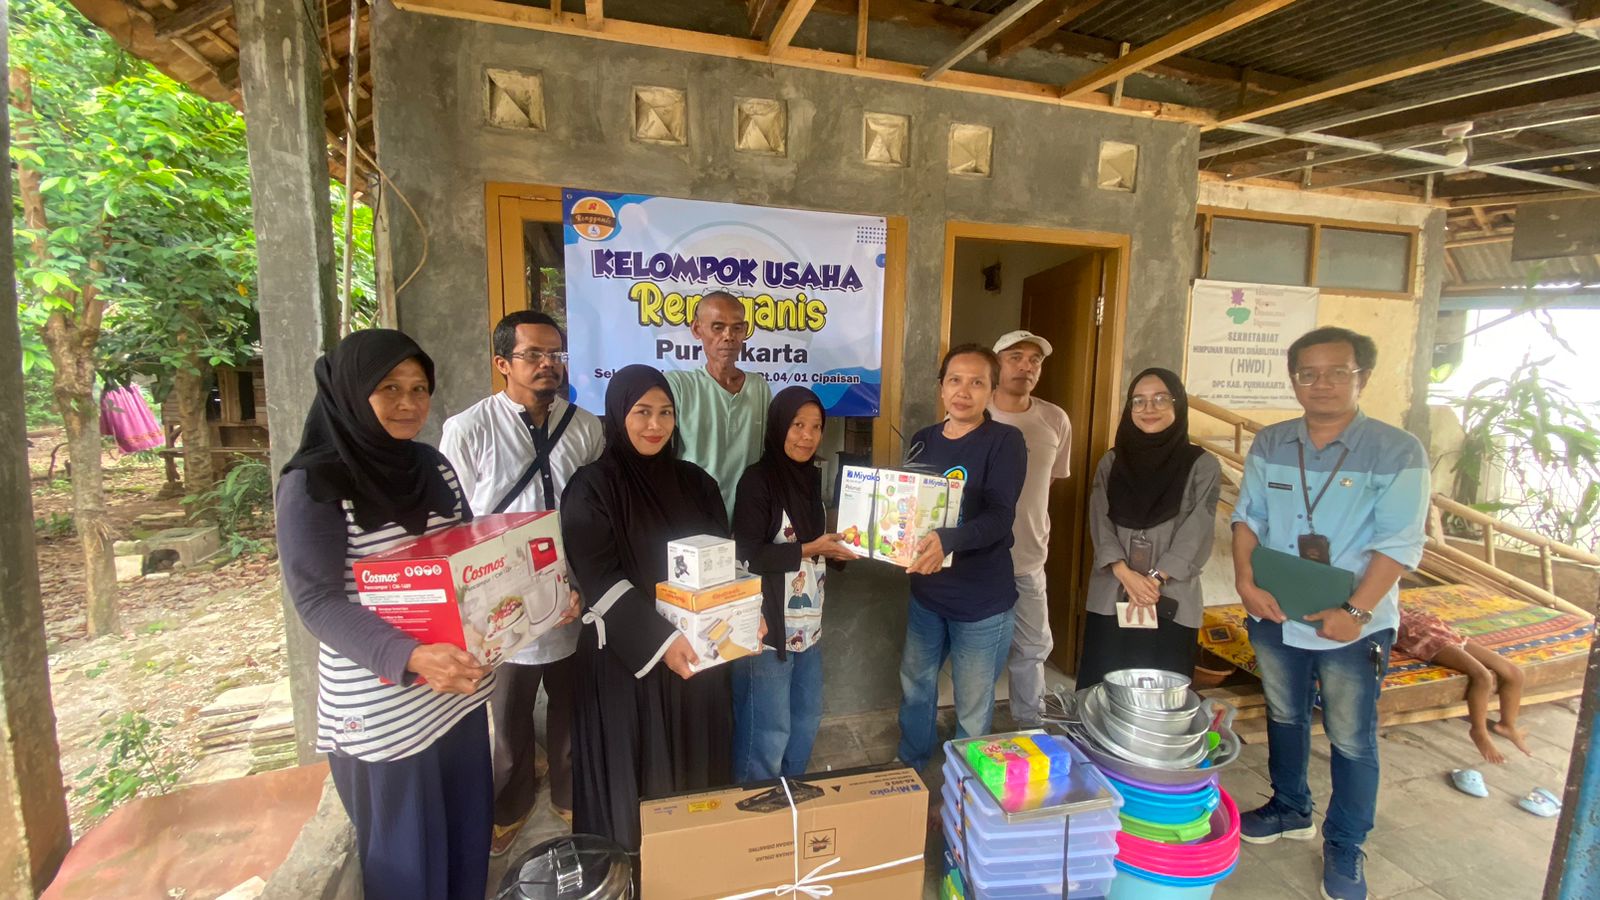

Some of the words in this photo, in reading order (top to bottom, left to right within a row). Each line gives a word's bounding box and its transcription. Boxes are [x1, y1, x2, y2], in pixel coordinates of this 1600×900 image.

[592, 249, 758, 287] KELOMPOK
[763, 261, 863, 291] USAHA
[1227, 331, 1279, 343] SEKRETARIAT
[656, 339, 807, 363] Purkarta
[854, 470, 880, 482] Miyako
[361, 569, 398, 584] Cosmos
[462, 557, 505, 584] Cosmos
[870, 785, 910, 796] Miyako
[775, 840, 794, 849] ANGAN
[775, 850, 794, 858] ANGAN
